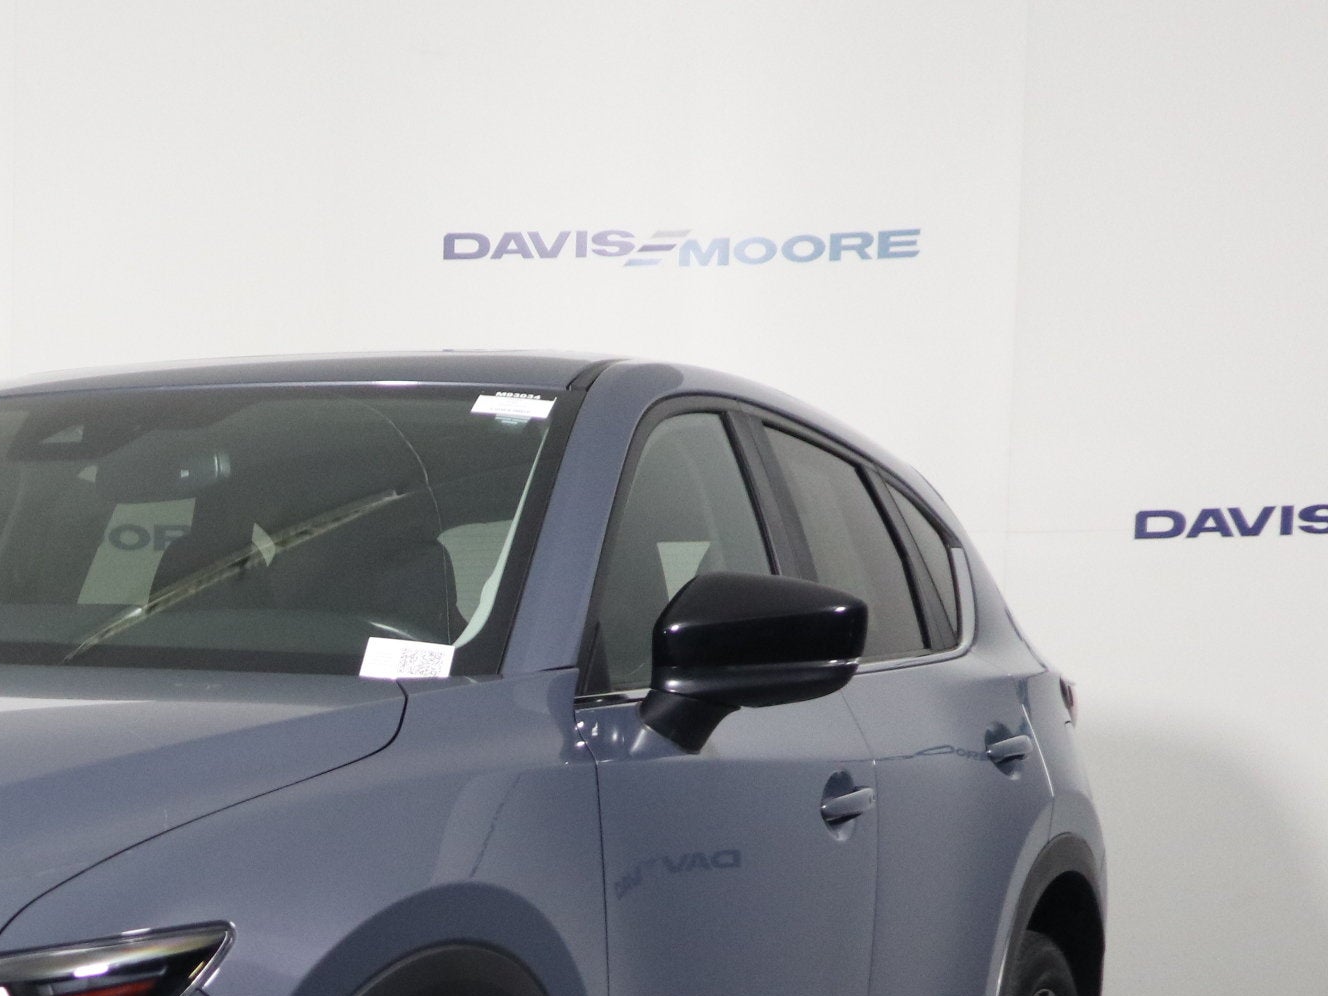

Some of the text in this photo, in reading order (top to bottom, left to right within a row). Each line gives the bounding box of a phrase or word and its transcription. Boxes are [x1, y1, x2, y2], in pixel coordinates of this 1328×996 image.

[443, 228, 922, 267] DAVIS MOORE
[1133, 504, 1328, 540] DAVIS
